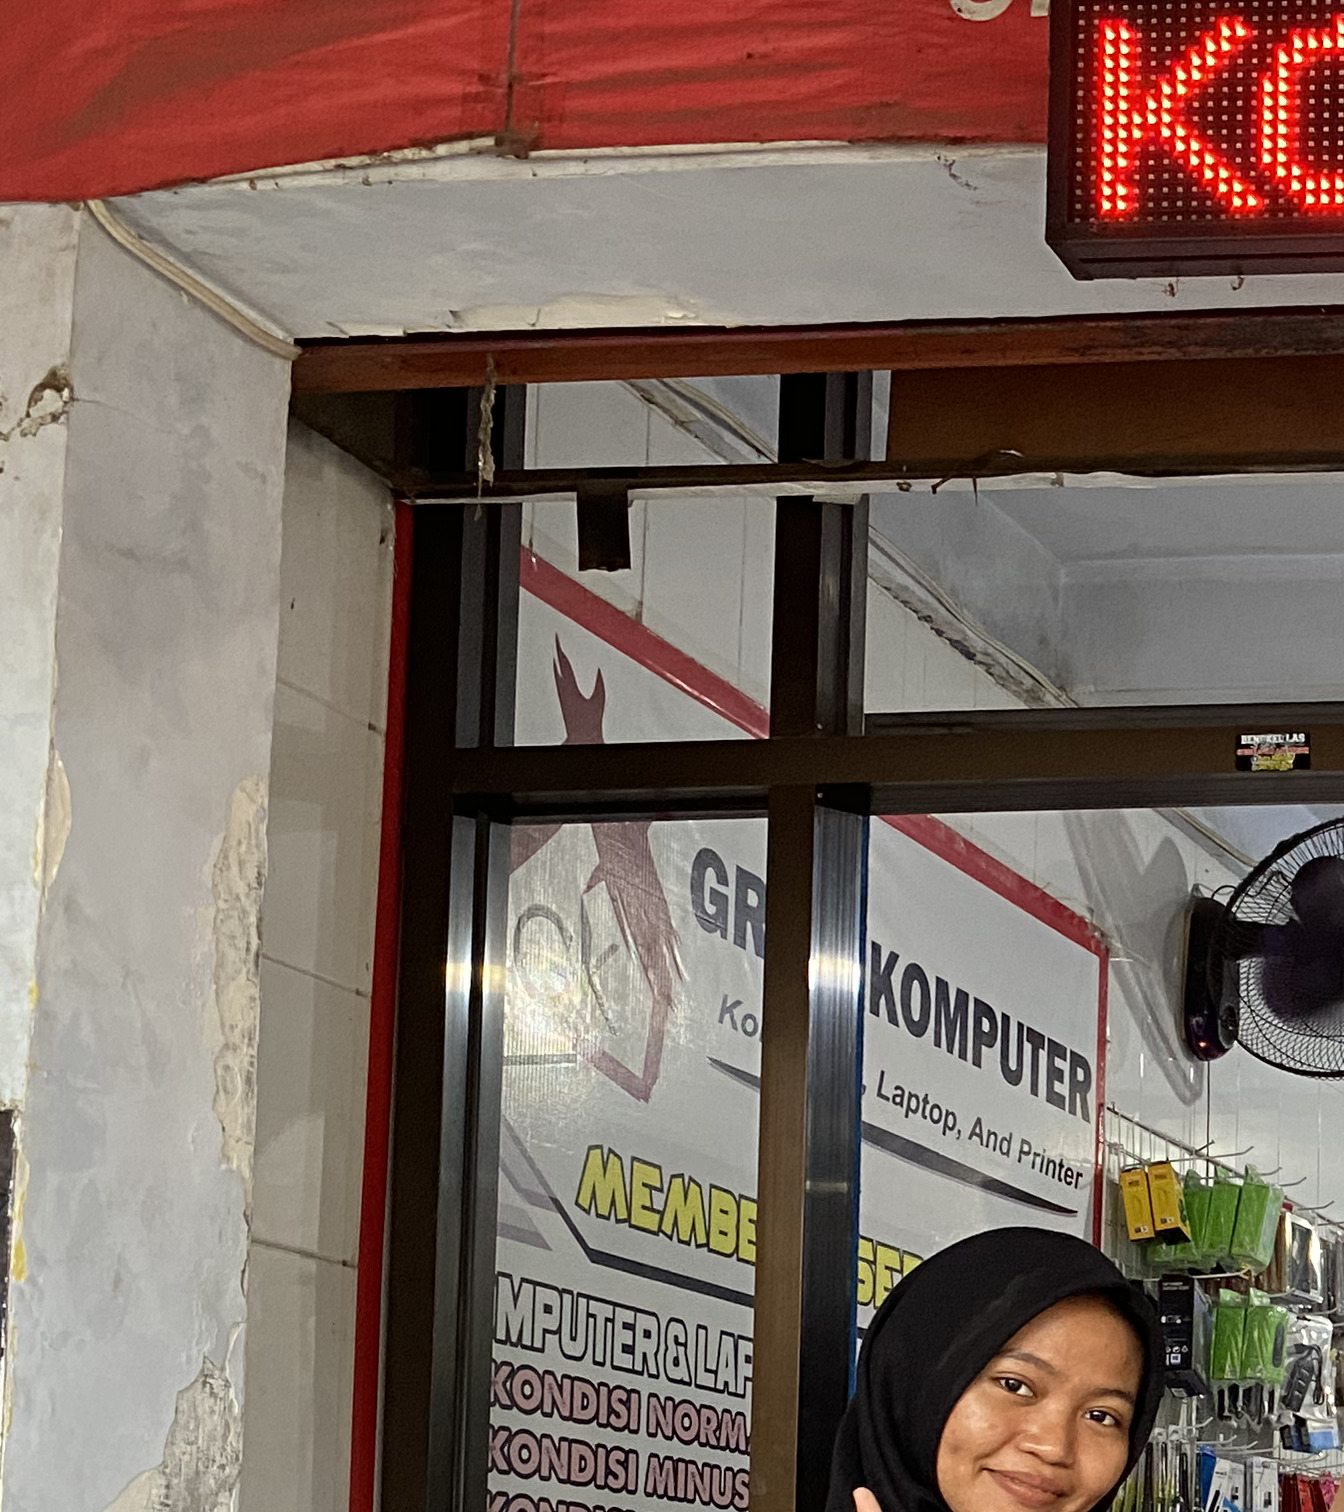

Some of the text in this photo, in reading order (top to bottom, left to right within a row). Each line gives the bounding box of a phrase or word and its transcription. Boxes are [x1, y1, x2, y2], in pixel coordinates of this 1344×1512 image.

[869, 941, 1092, 1122] KOMPUTER
[876, 1068, 1084, 1190] Laptop, And Printer
[857, 1235, 924, 1310] SE
[494, 1273, 659, 1378] MPUTER
[665, 1319, 691, 1384] &
[490, 1360, 752, 1455] KONDISI NORM
[488, 1425, 750, 1509] KONDISI MINUS
